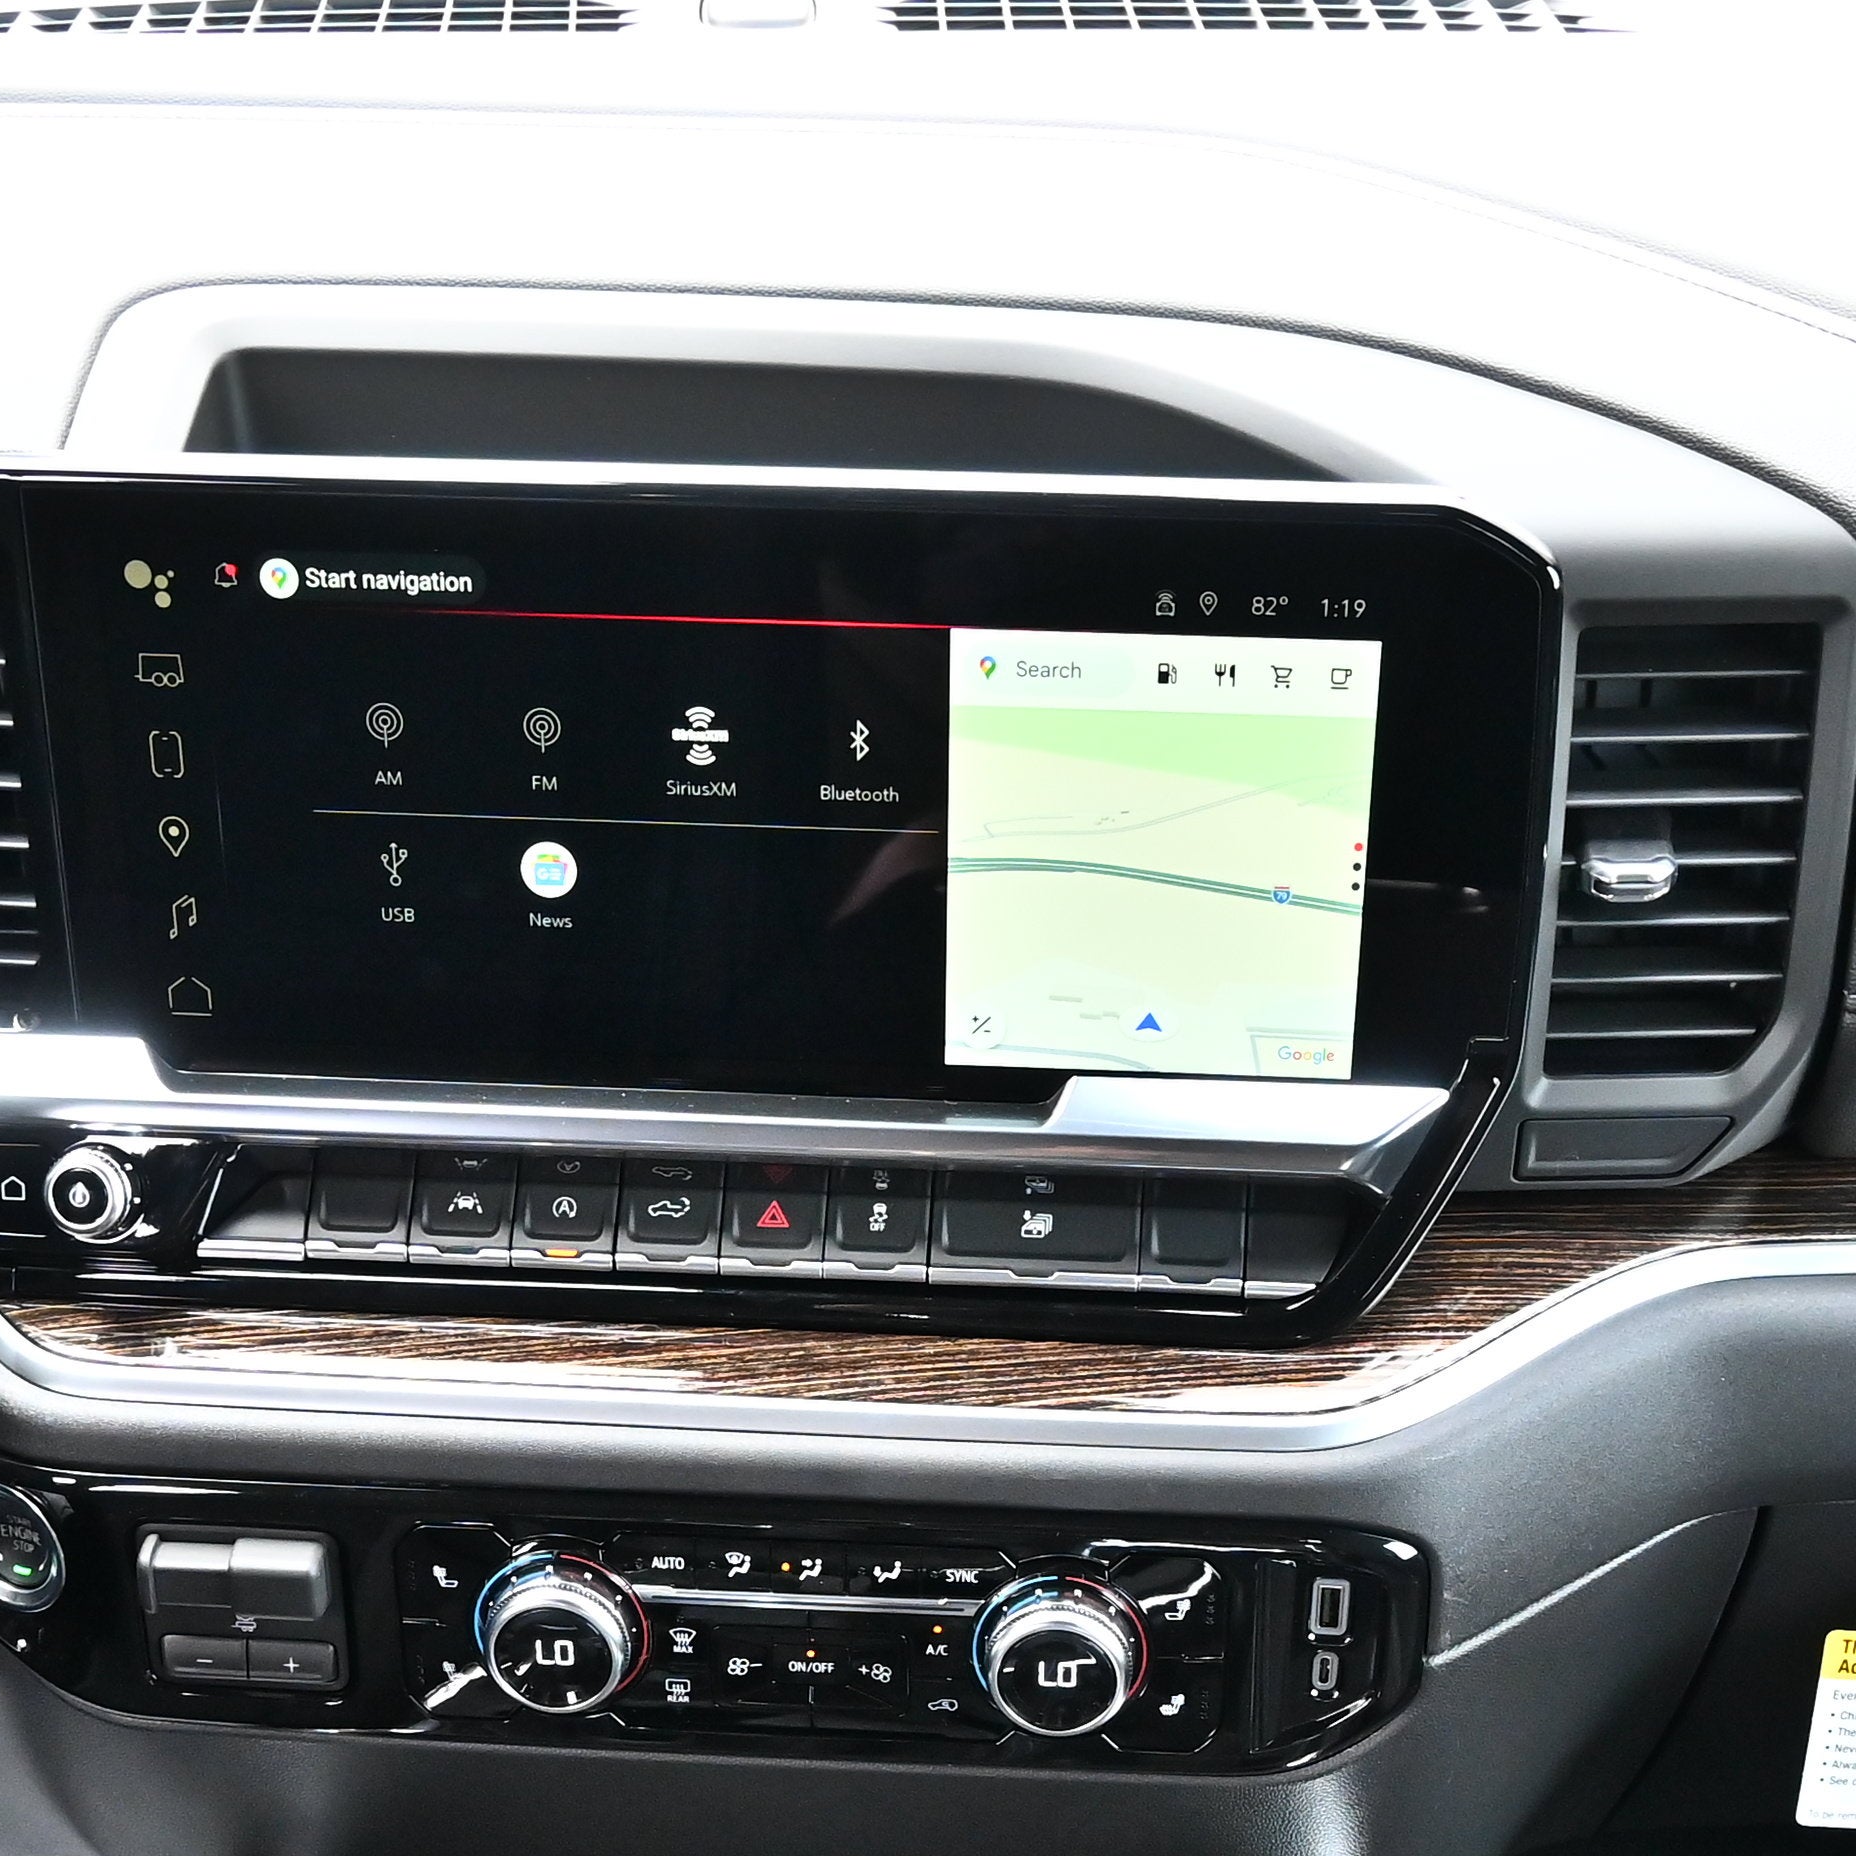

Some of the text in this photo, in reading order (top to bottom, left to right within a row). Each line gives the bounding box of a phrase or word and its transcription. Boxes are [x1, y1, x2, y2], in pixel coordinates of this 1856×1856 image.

[305, 567, 473, 595] Start navigation
[1321, 598, 1366, 618] 1:19
[1016, 660, 1082, 679] Search
[375, 771, 402, 785] AM
[532, 776, 557, 790] FM
[666, 780, 736, 797] SiriusXM
[820, 785, 899, 802] Bluetooth
[381, 907, 415, 922] USB
[529, 913, 573, 928] News
[1278, 1046, 1334, 1065] Google
[869, 1222, 886, 1232] OFF
[651, 1556, 685, 1570] AUTO
[945, 1570, 979, 1584] SYNC
[673, 1645, 694, 1654] MAX
[925, 1644, 949, 1656] A/C
[788, 1661, 835, 1674] ON/OFF
[667, 1695, 690, 1703] REAR
